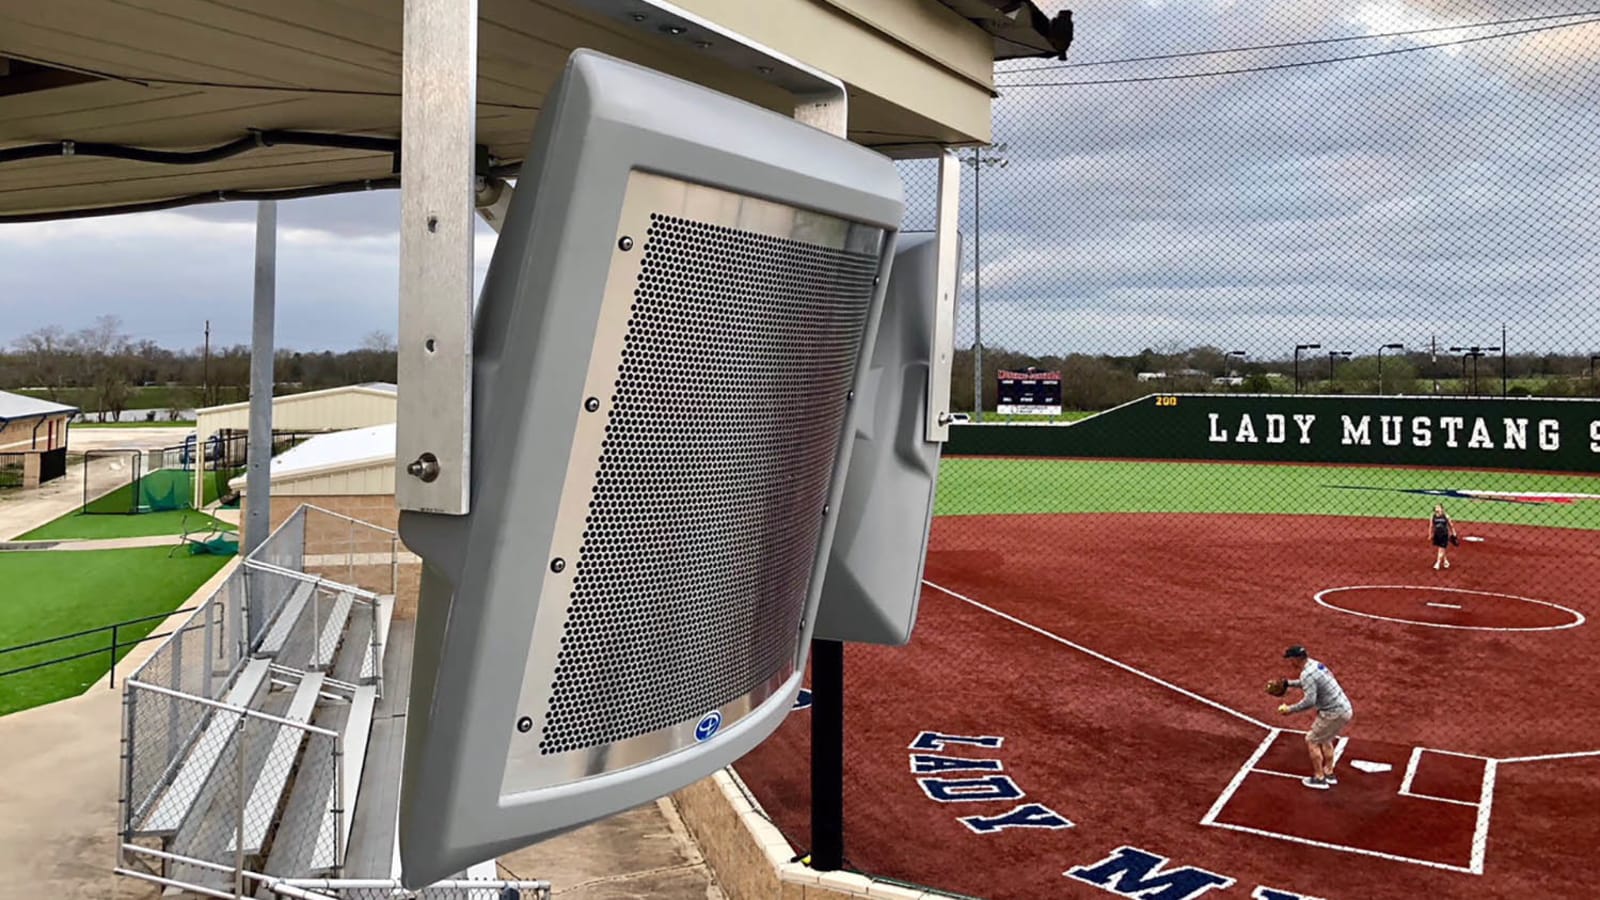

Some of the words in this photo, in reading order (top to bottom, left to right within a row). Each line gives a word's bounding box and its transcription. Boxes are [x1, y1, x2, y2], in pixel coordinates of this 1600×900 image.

[1155, 396, 1177, 406] 200
[1208, 413, 1316, 444] LADY
[1340, 415, 1560, 451] MUSTANG
[907, 730, 1077, 834] LADY
